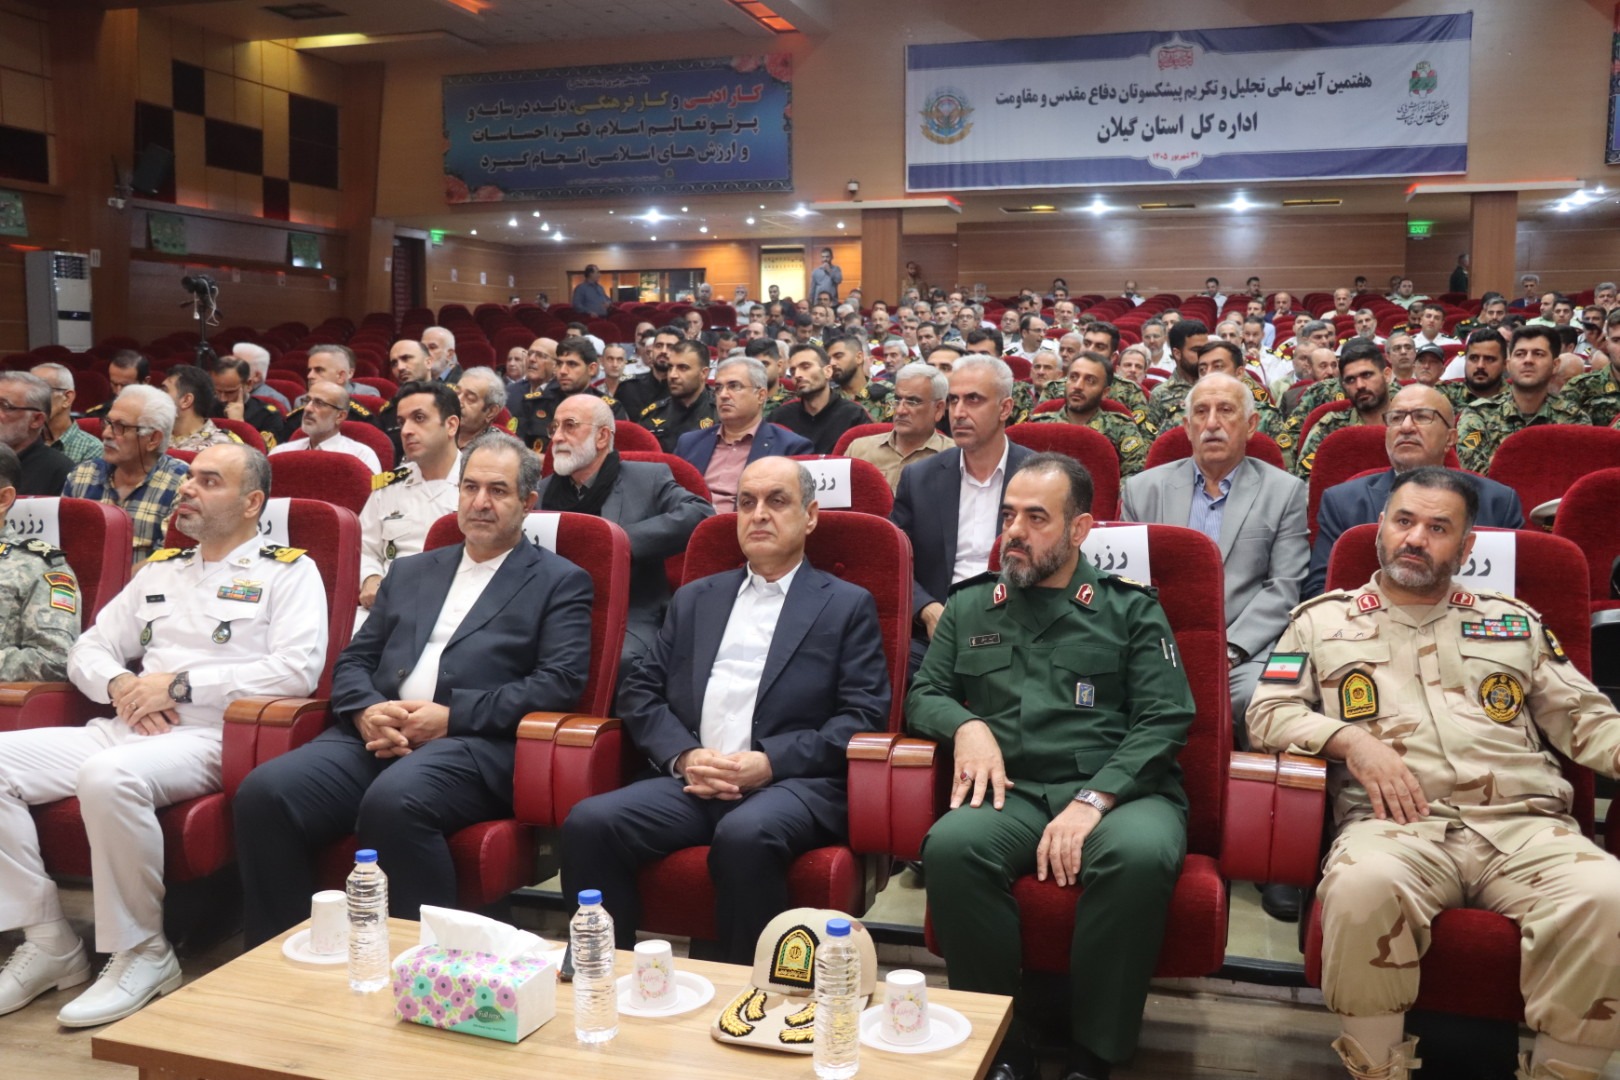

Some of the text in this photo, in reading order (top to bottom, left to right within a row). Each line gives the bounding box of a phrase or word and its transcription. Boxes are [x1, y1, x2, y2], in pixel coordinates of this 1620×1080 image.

[682, 86, 727, 110] ادبی
[728, 84, 764, 108] کار
[995, 72, 1372, 109] هفتمین آیین ملی تجلیل و تکریم پیشکسوتان دفاع مقدس و مقاومت
[476, 99, 513, 119] سایه
[516, 101, 531, 118] در
[533, 96, 567, 117] باید
[637, 91, 669, 112] کار
[671, 96, 679, 111] و
[466, 108, 474, 122] و
[472, 124, 549, 143] احساسات
[648, 115, 707, 137] تعالیم
[1097, 111, 1258, 143] اداره کل استان گیلان
[531, 147, 587, 170] انجام
[587, 144, 655, 167] اسلامی
[739, 145, 749, 162] و
